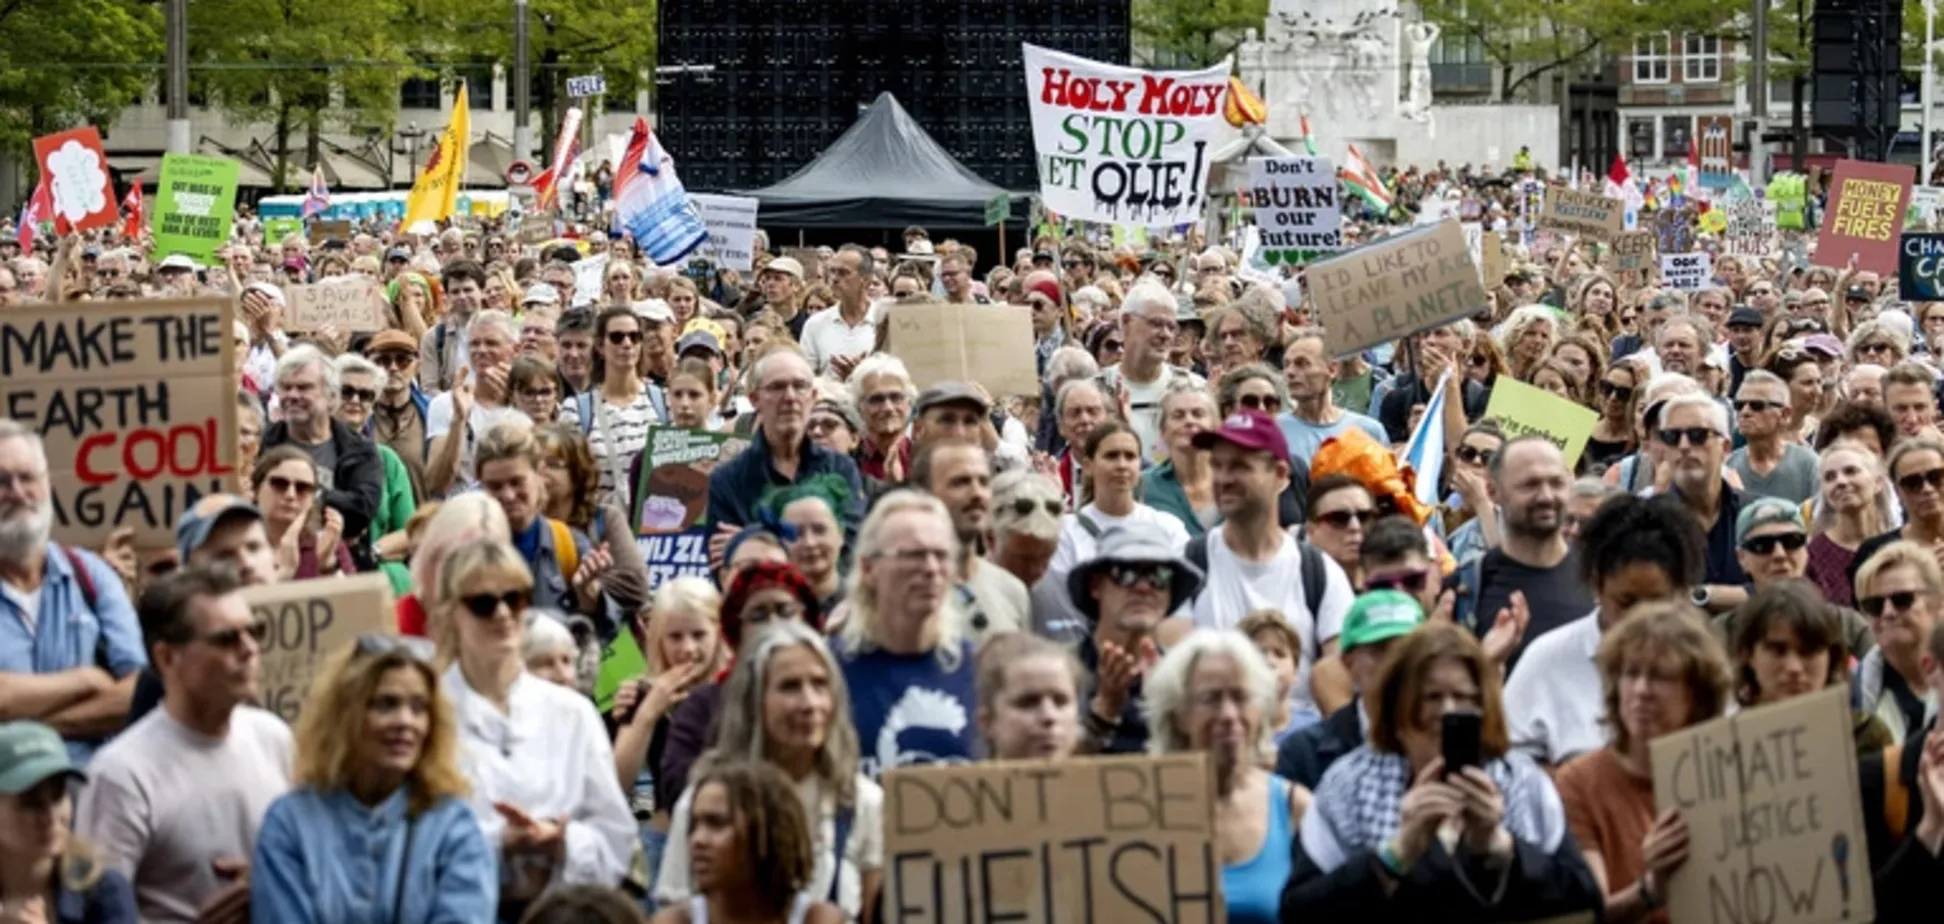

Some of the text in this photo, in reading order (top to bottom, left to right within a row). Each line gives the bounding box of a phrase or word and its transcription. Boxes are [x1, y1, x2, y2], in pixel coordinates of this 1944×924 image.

[569, 77, 603, 94] HELP
[1041, 67, 1225, 116] HOLY MOLY
[1058, 114, 1185, 160] STOP
[1091, 140, 1207, 212] OLIE!
[1265, 159, 1314, 174] Don't
[1253, 185, 1333, 208] BURN
[1838, 200, 1897, 221] FUELS
[1844, 179, 1901, 202] MONEY
[1259, 228, 1342, 246] future!
[1275, 212, 1316, 225] our
[1832, 217, 1893, 241] FIRES
[1364, 249, 1409, 277] LIKE
[1417, 237, 1441, 262] TO
[1327, 278, 1394, 315] LEAVE
[1401, 264, 1430, 288] MY
[1343, 280, 1465, 344] A PLANET
[2, 314, 222, 376] MAKE THE
[8, 382, 169, 438] EARTH
[75, 417, 234, 484] COOL
[250, 598, 333, 653] OOP
[894, 762, 1206, 835] DON'T BE
